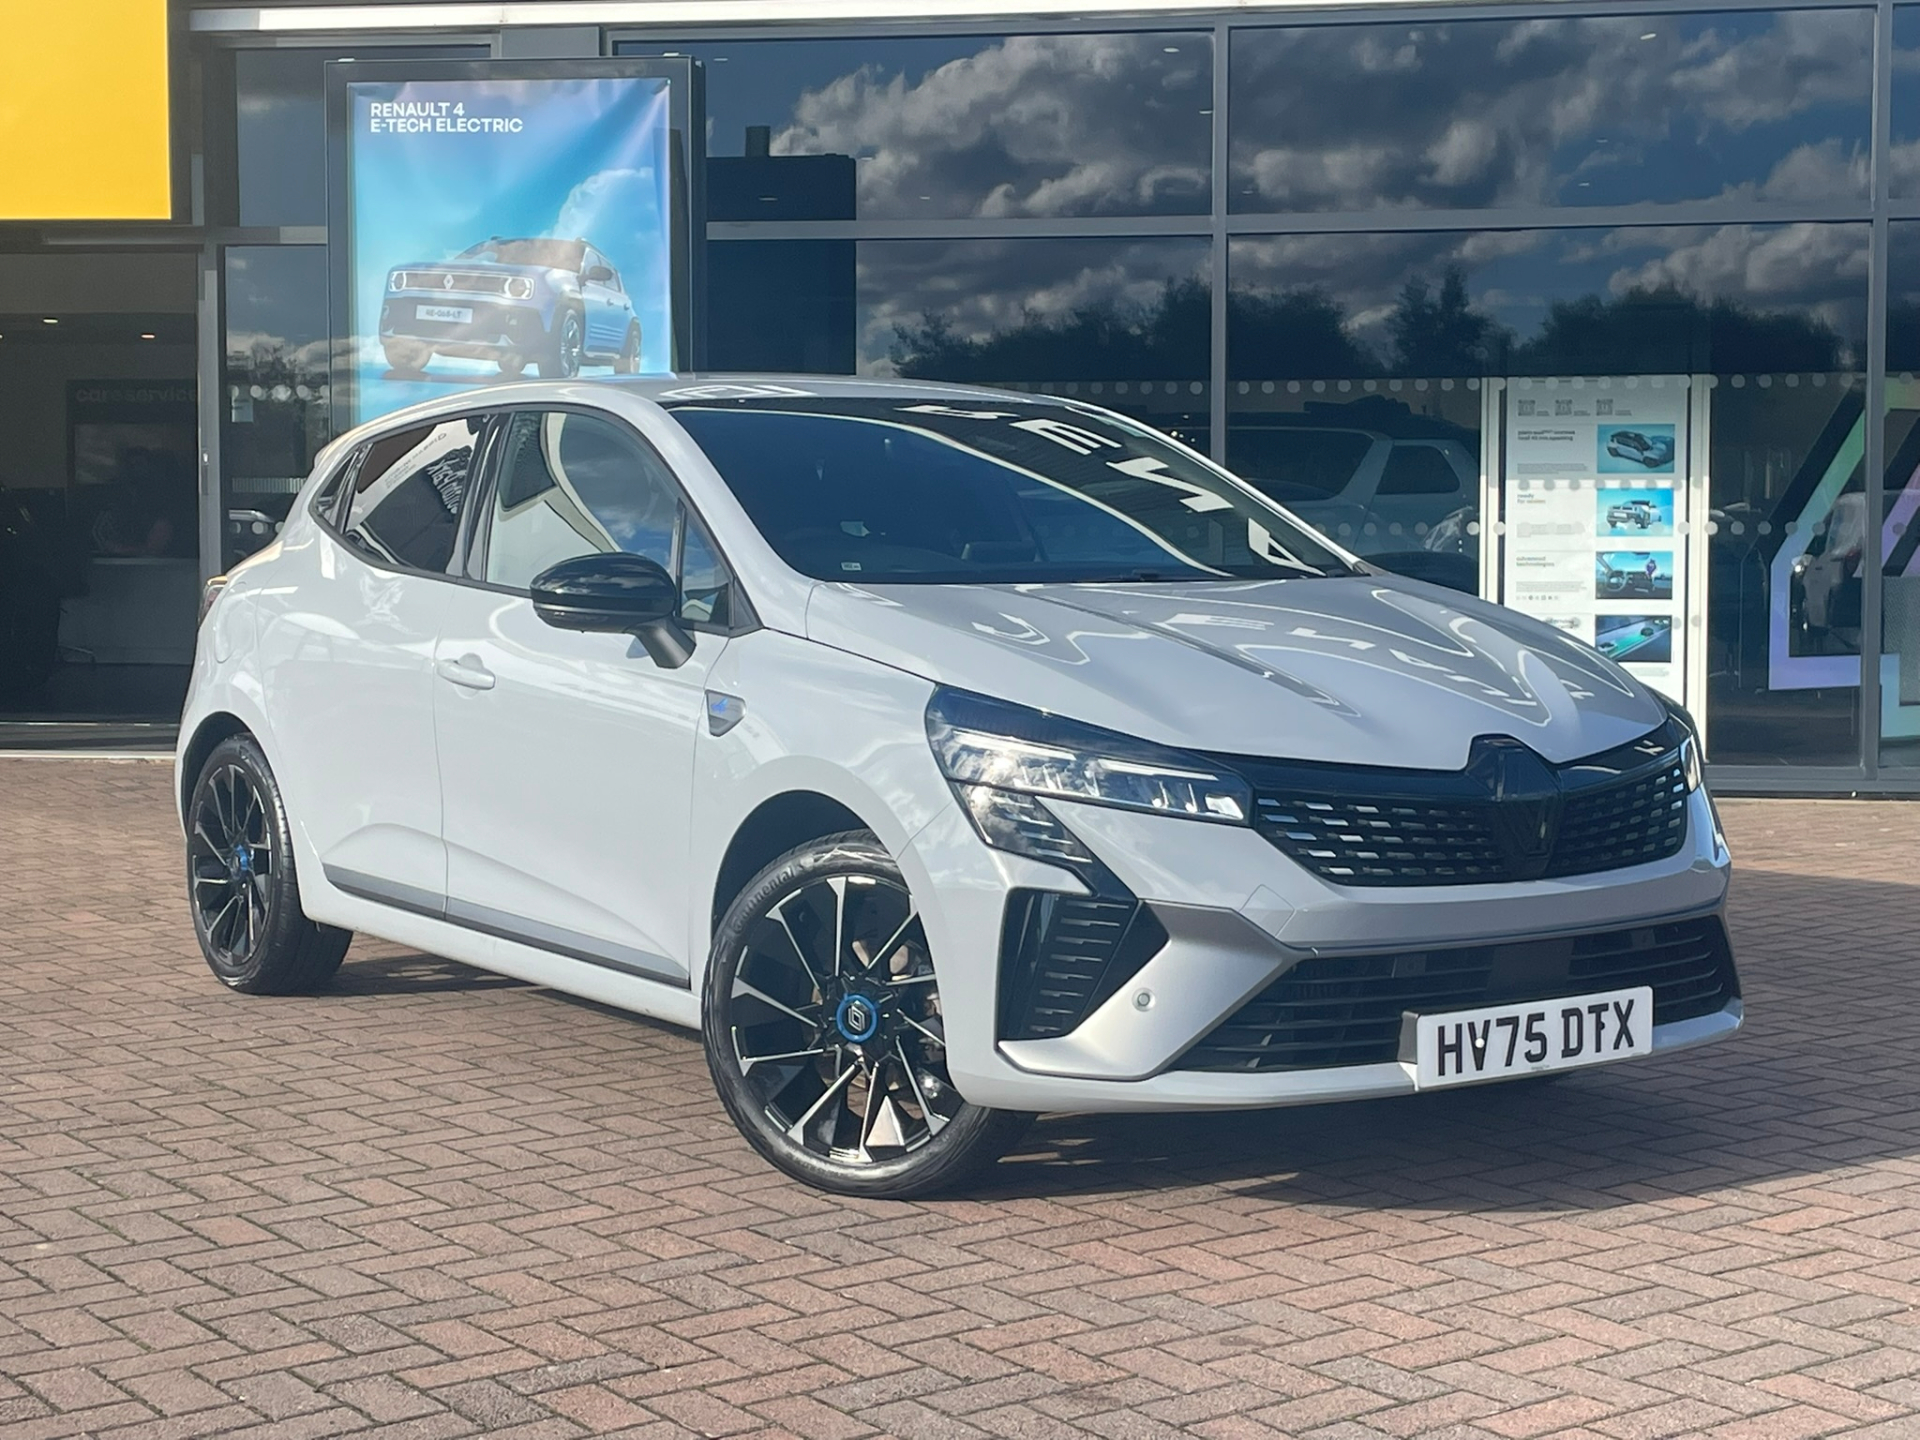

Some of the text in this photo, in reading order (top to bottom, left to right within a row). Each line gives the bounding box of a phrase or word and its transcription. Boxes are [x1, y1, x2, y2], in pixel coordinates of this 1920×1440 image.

[371, 102, 465, 117] RENAULT 4
[371, 118, 523, 133] E-TECH ELECTRIC
[1437, 999, 1635, 1077] HV75 DTX
